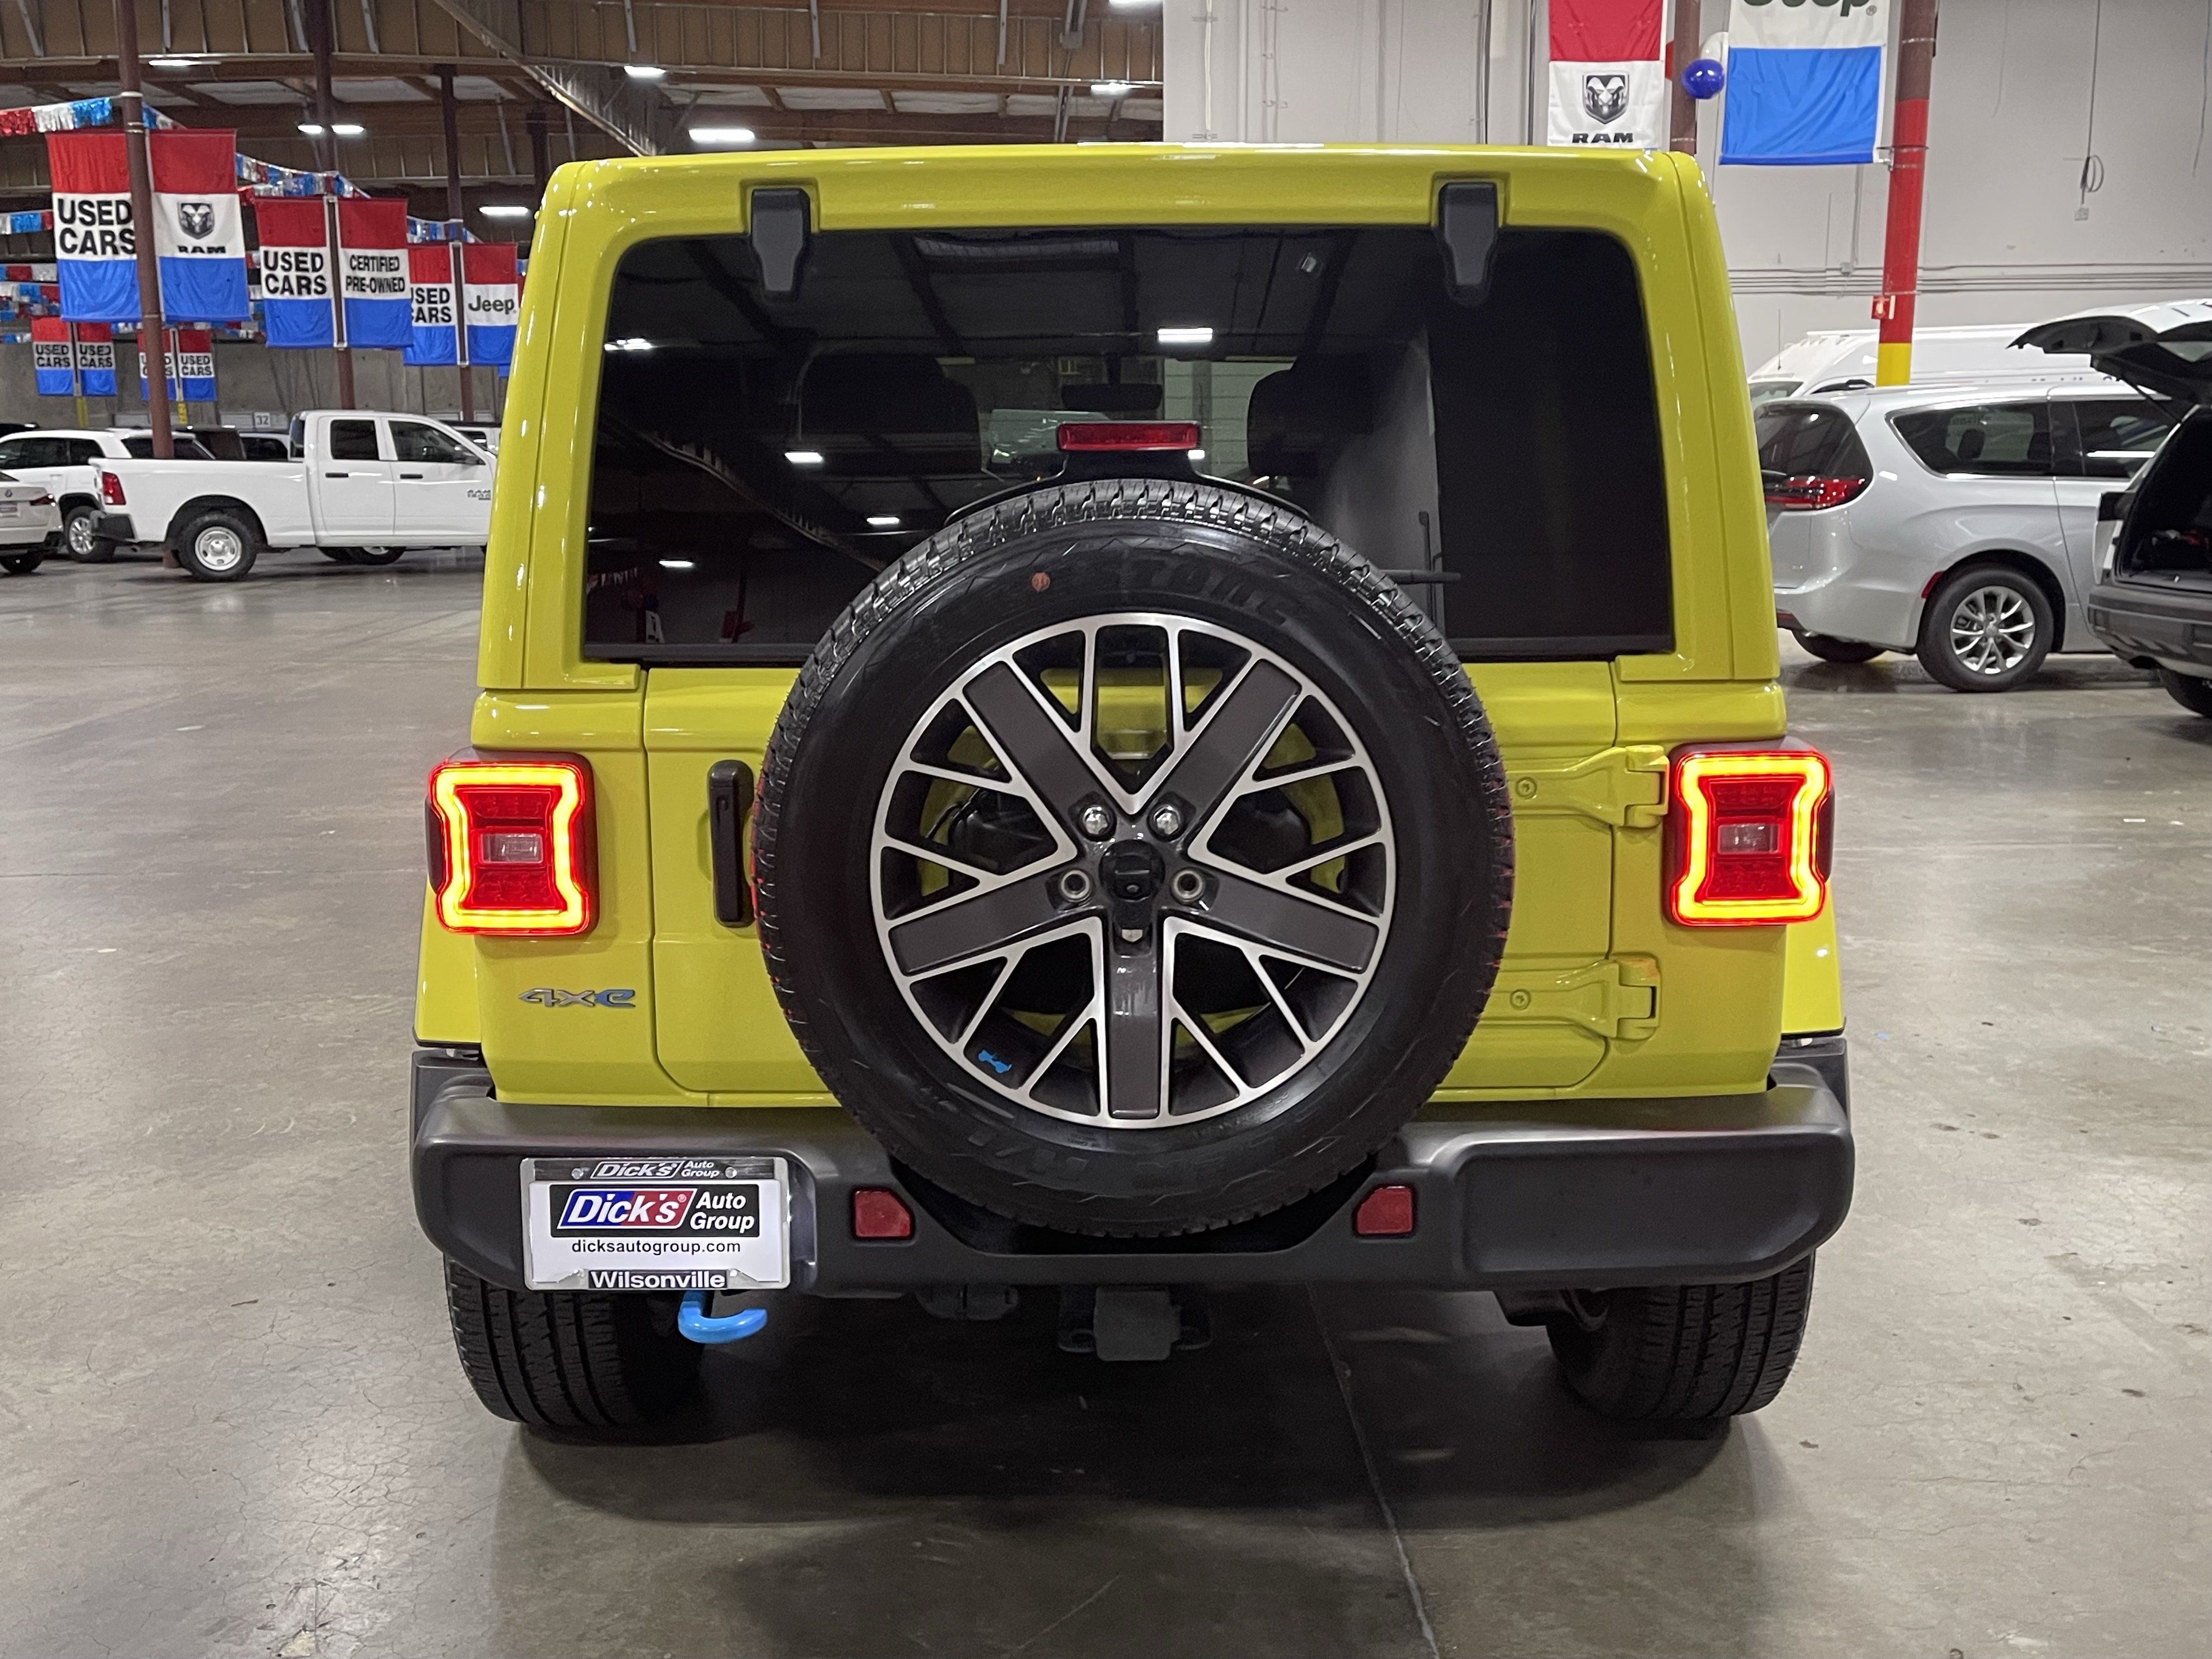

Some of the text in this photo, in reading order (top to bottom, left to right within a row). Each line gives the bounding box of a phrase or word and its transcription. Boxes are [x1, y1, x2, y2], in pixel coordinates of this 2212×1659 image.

[1572, 132, 1633, 144] RAM
[58, 198, 133, 226] USED
[59, 228, 136, 255] CARS
[177, 245, 227, 254] RAM
[263, 251, 324, 273] USED
[349, 255, 400, 271] CERTIFIED
[264, 275, 326, 295] CARS
[345, 275, 405, 294] PRE-OWNED
[469, 295, 515, 314] Jeep
[411, 306, 452, 323] ARS
[36, 344, 69, 355] USED
[80, 344, 111, 356] USED
[37, 357, 70, 367] CARS
[80, 357, 113, 368] CARS
[180, 355, 210, 365] USED
[182, 366, 212, 376] CARS
[597, 1160, 714, 1177] Dick's Auto
[681, 1169, 720, 1178] Group
[567, 1191, 746, 1223] Dick's Auto
[690, 1212, 755, 1233] Group
[572, 1240, 741, 1256] dicksautogroup.com
[590, 1271, 726, 1289] Wilsonville
